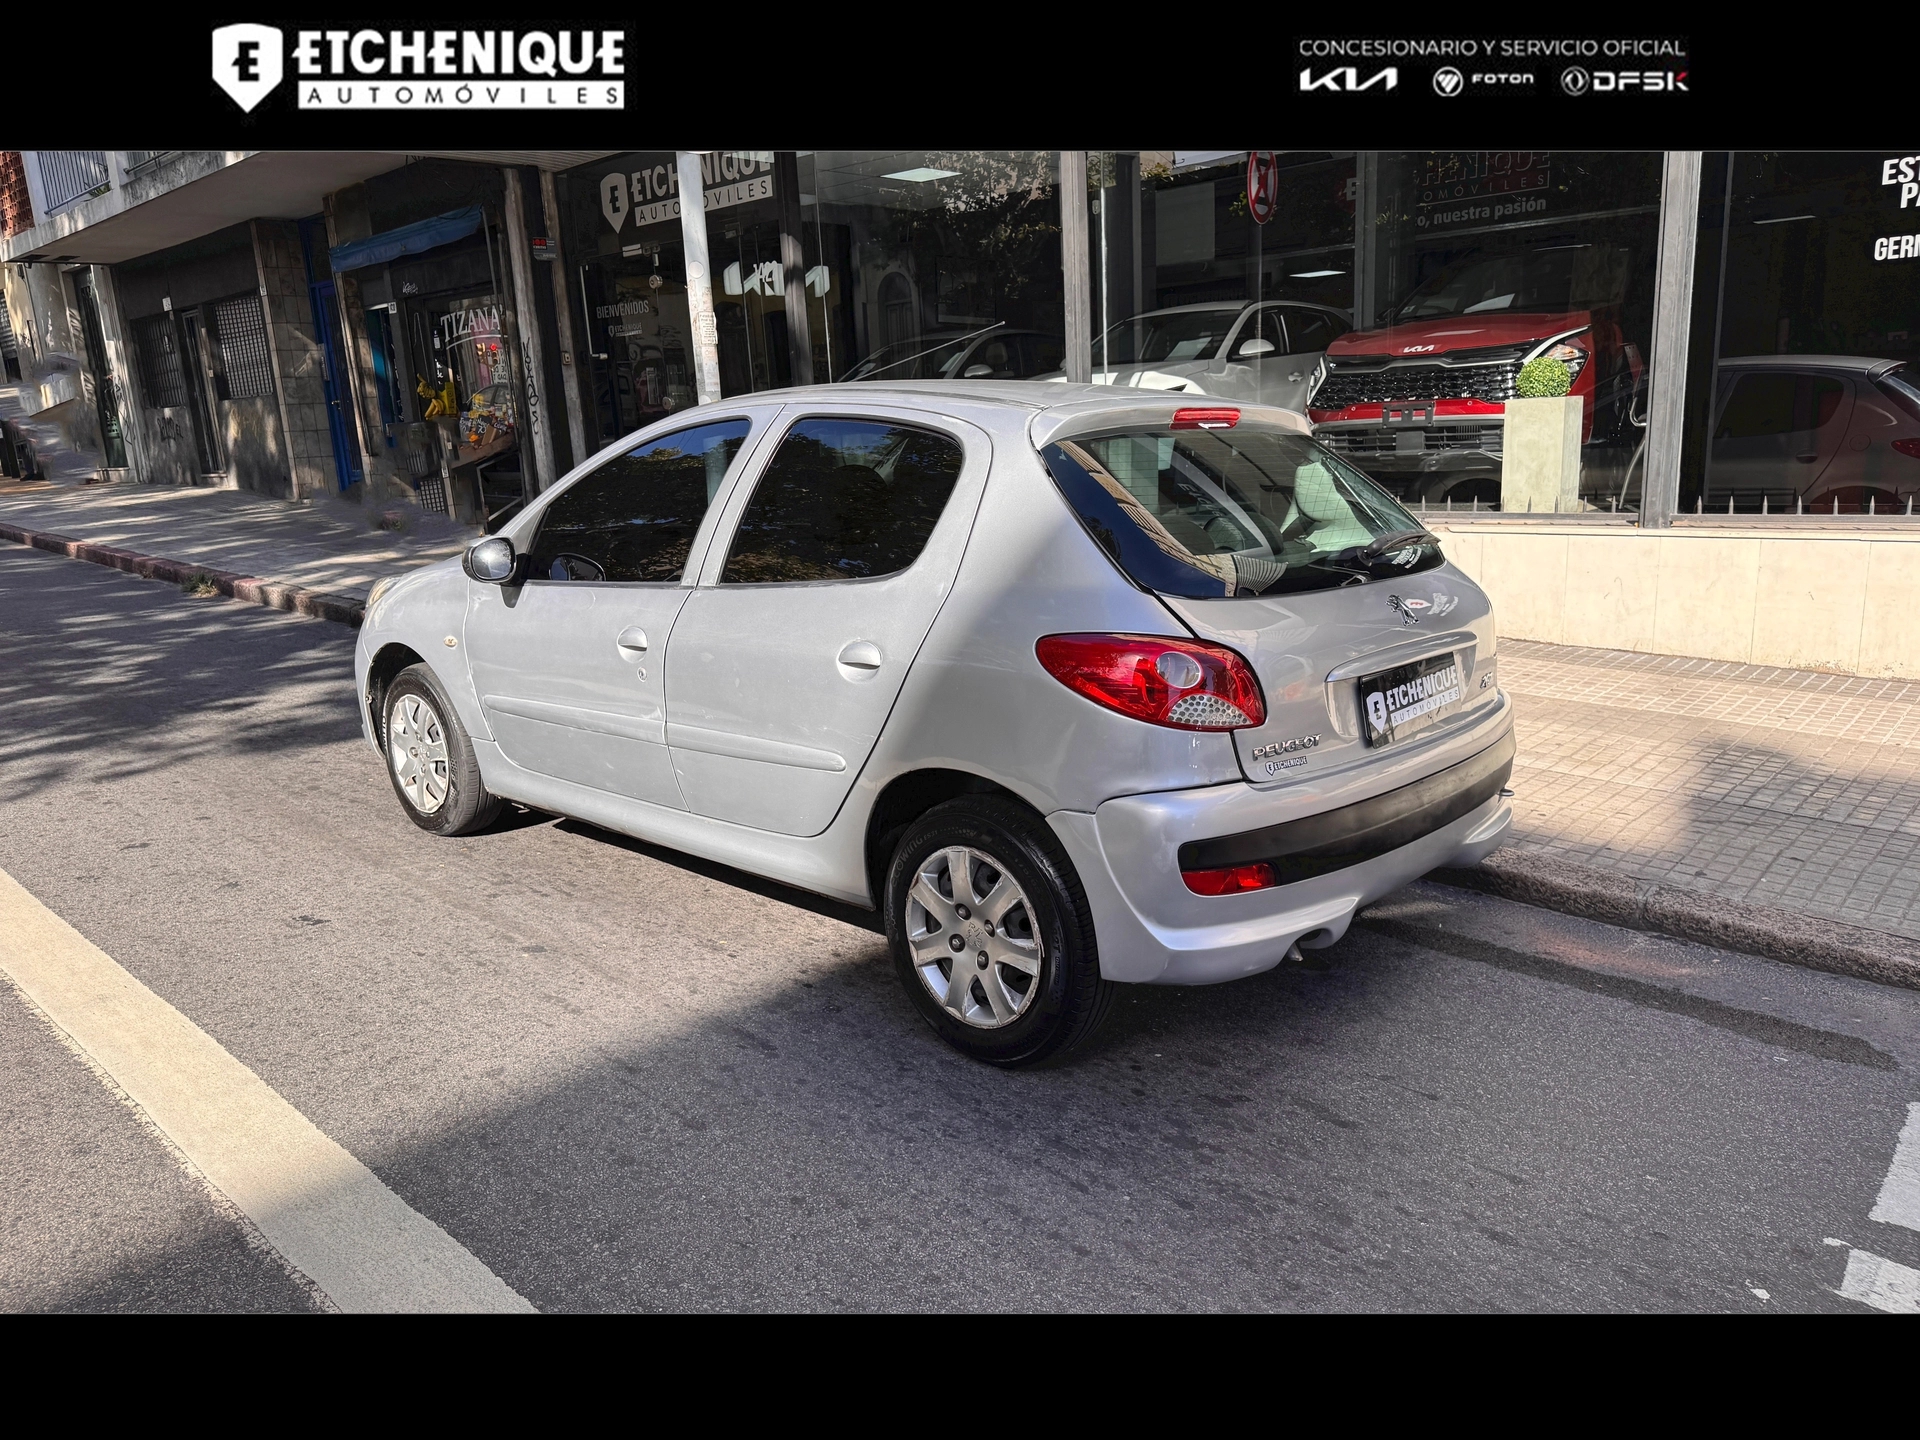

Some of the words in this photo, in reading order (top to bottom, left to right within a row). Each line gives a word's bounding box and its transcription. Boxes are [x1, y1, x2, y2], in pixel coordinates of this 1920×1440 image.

[630, 152, 772, 203] ETCHNIQUE
[638, 180, 768, 223] AUTOÓVILES
[1900, 182, 1920, 208] P
[1434, 204, 1491, 225] nuestra
[1494, 198, 1547, 220] pasión
[596, 300, 650, 319] BIENVENIDOS
[1403, 344, 1435, 353] KIA
[1386, 665, 1457, 711] ETCHENIQUE
[1252, 733, 1322, 761] PEUGEOT
[1274, 756, 1308, 771] ETCHENIQUE
